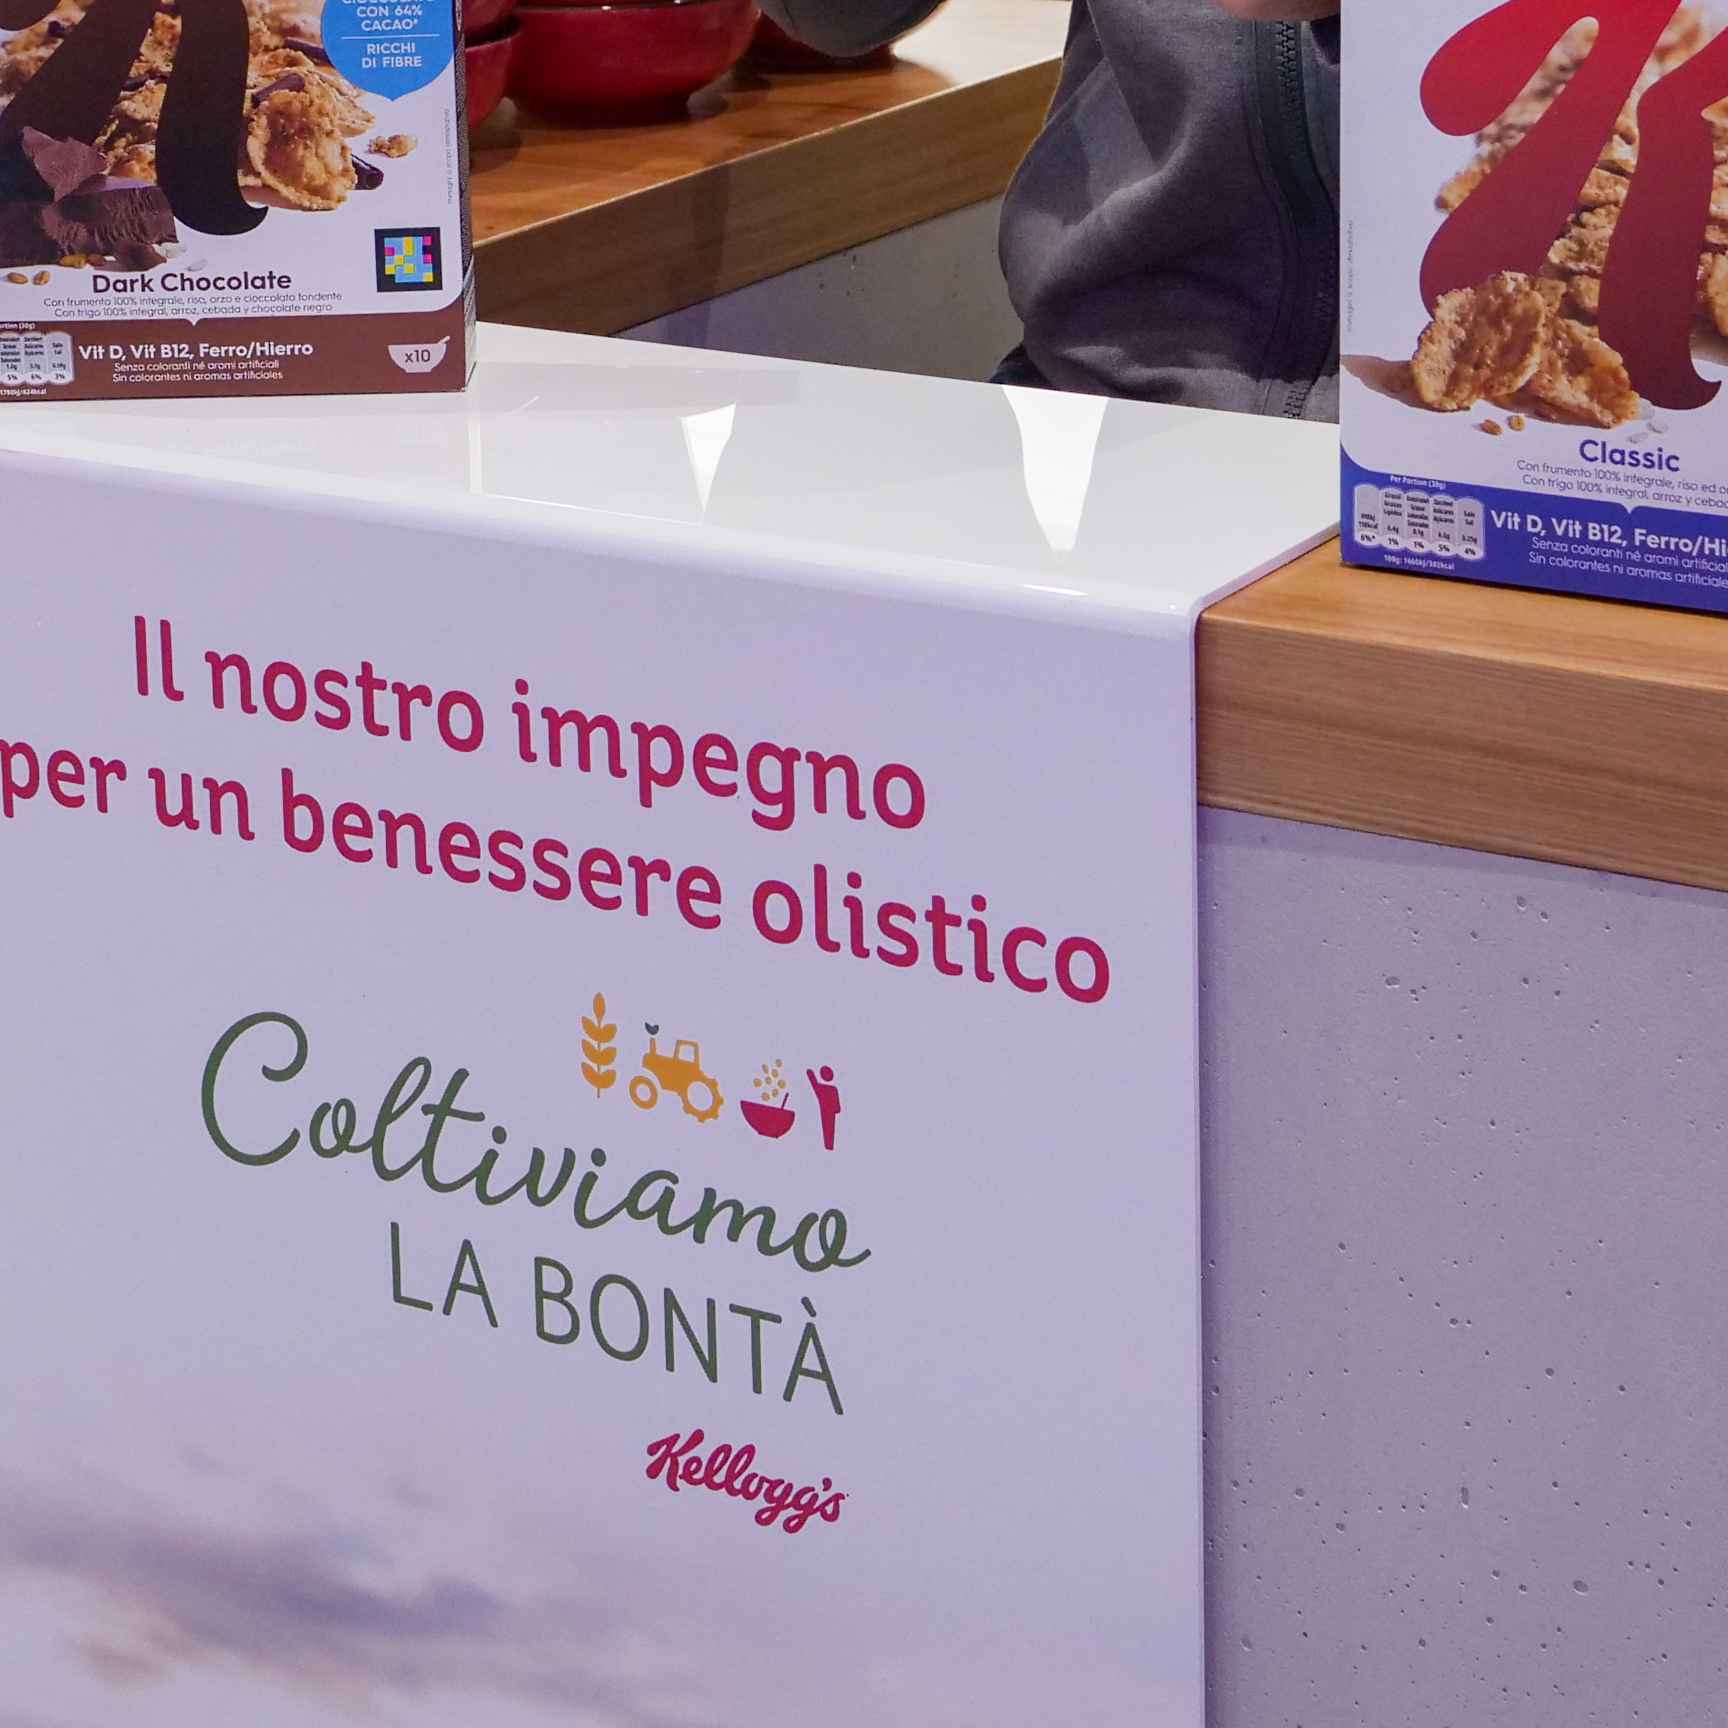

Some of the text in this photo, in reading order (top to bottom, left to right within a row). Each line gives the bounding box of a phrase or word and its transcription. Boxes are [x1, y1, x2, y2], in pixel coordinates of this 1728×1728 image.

[356, 5, 423, 18] CON 64%
[361, 55, 423, 69] DI FIBRE
[366, 42, 417, 55] RICCHI
[92, 271, 292, 294] Dark Chocolate
[43, 296, 65, 308] Con
[66, 296, 112, 308] frumento
[113, 296, 137, 307] 100%
[138, 295, 186, 308] integrale,
[210, 293, 233, 304] orzo
[234, 295, 241, 303] e
[243, 291, 296, 303] cioccolato
[297, 291, 343, 303] fondente
[53, 307, 75, 318] Con
[76, 307, 101, 319] trigo
[102, 307, 127, 317] 100%
[129, 305, 169, 318] integral,
[201, 303, 241, 315] cebada
[243, 305, 250, 316] y
[250, 302, 302, 314] chocolate
[303, 303, 334, 314] negro
[78, 341, 314, 362] Vit D, Vit B12, Ferro/Hierro
[114, 358, 280, 373] Senza coloranti né aromi artificiali
[403, 348, 431, 363] x10
[112, 369, 284, 383] Sin colorantes ni aromas artificiales
[1578, 438, 1681, 473] Classic
[1516, 459, 1540, 473] Con
[1541, 461, 1592, 480] frumento
[1593, 467, 1622, 483] 100%
[1623, 470, 1676, 492] integrale,
[1677, 479, 1700, 492] riso
[1700, 481, 1717, 495] ed
[1522, 473, 1546, 488] Con
[1547, 476, 1575, 492] trigo
[1576, 479, 1604, 495] 100%
[1605, 483, 1649, 502] integral,
[1652, 490, 1684, 505] arroz
[1685, 494, 1694, 507] y
[1489, 509, 1522, 531] Vit
[1525, 515, 1547, 537] D,
[1551, 516, 1583, 539] Vit
[1587, 523, 1628, 547] B12,
[1528, 551, 1554, 567] Sin
[1555, 554, 1611, 573] colorantes
[1612, 560, 1624, 574] ni
[1626, 564, 1672, 582] aromas
[1531, 536, 1569, 554] Senza
[1570, 540, 1624, 560] coloranti
[1625, 547, 1642, 562] né
[1643, 550, 1680, 567] aromi
[132, 614, 927, 833] Il nostro impegno
[149, 771, 256, 843] un
[280, 765, 723, 932] benessere
[751, 864, 1112, 1005] olistico
[200, 1011, 874, 1274] Coltiviamo
[389, 1220, 846, 1417] LA BONTÀ
[645, 1427, 850, 1536] Kellogg's
